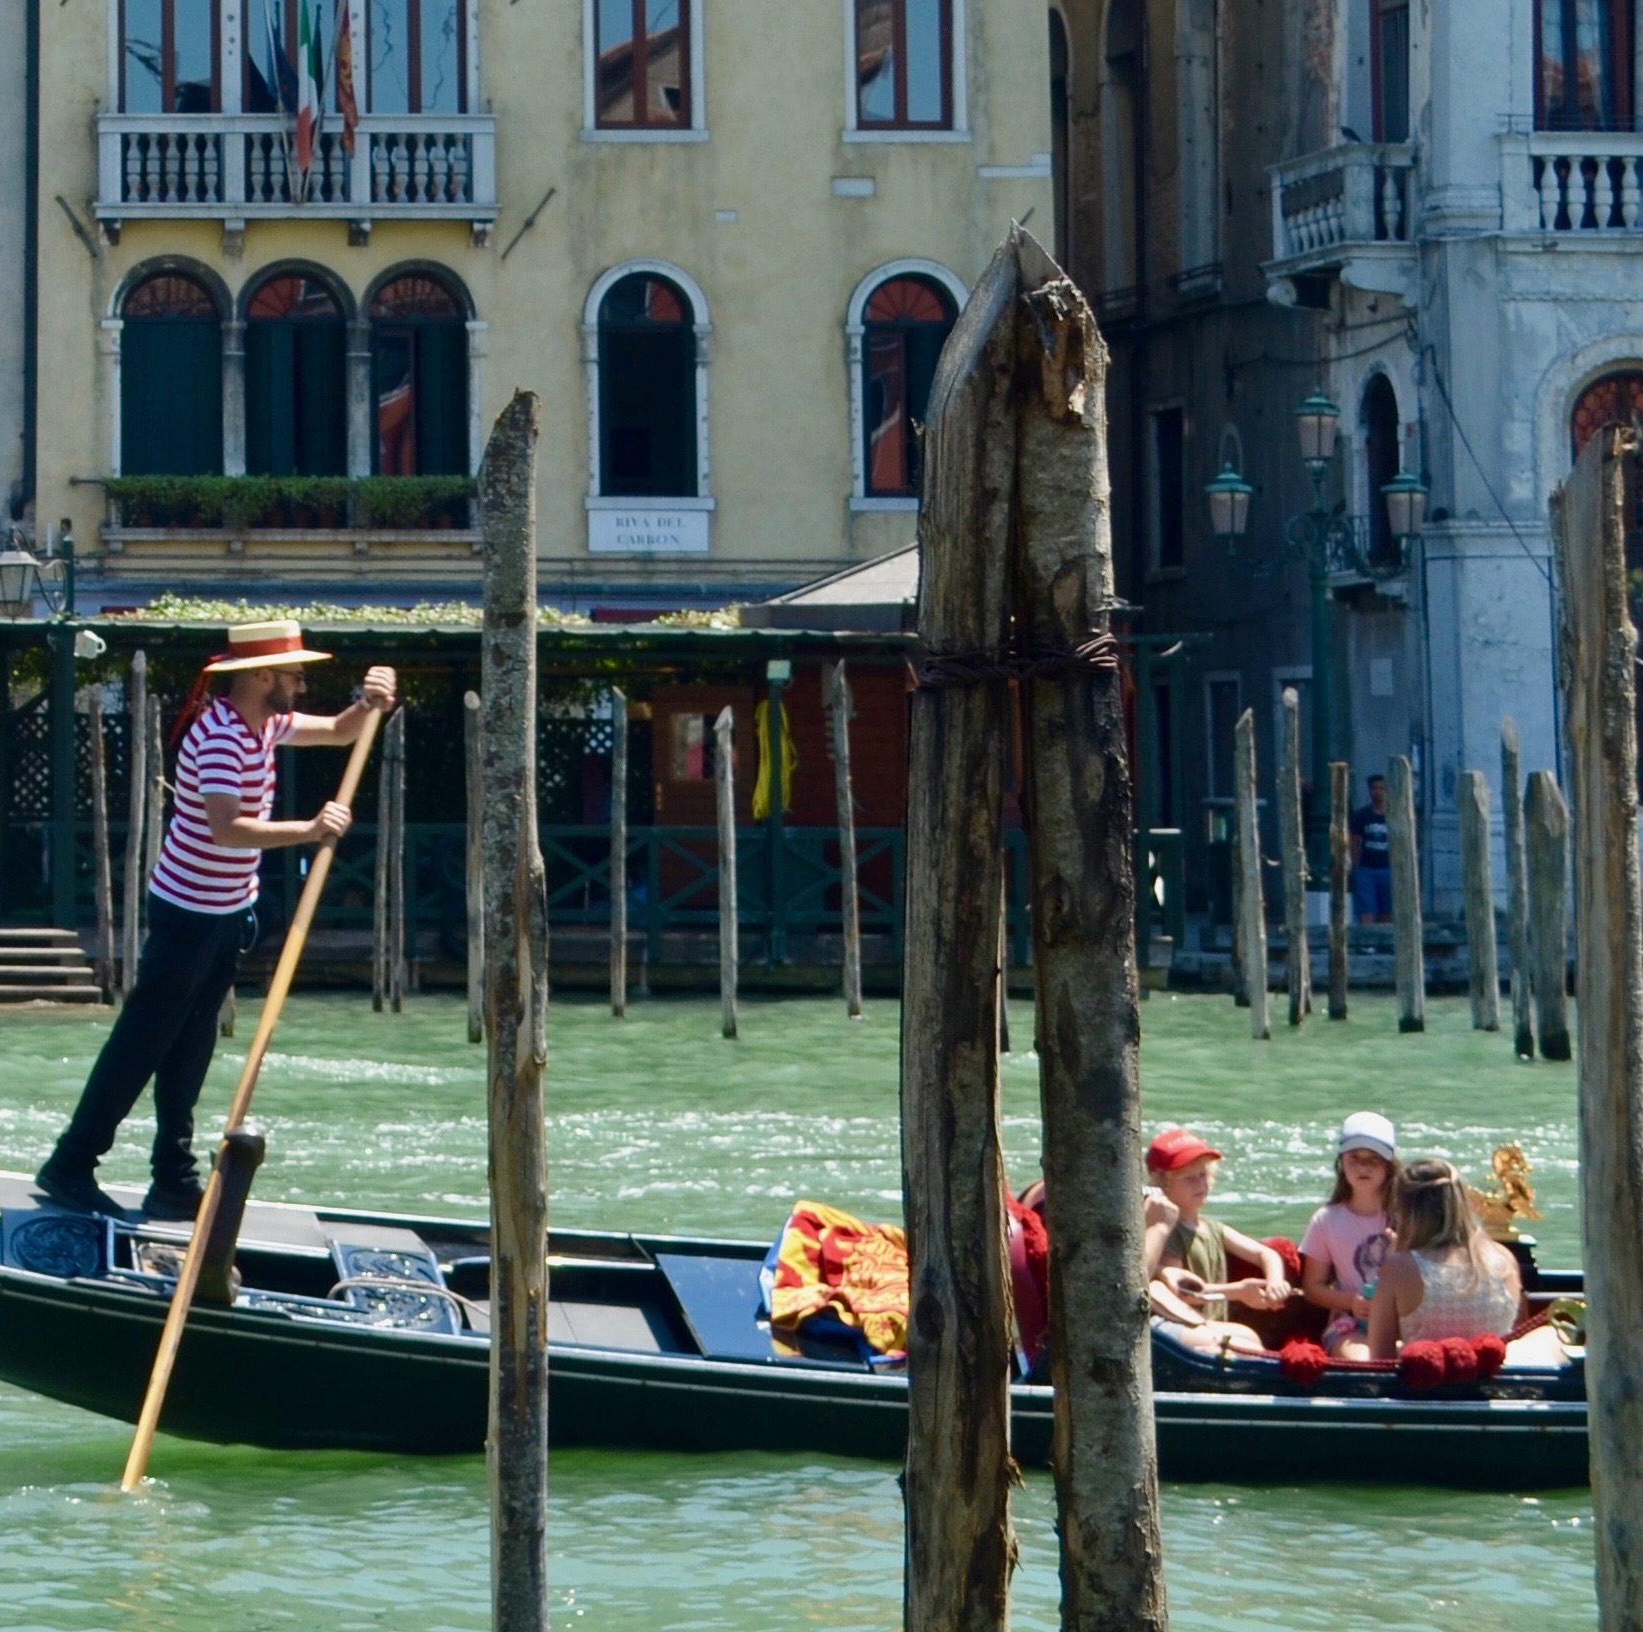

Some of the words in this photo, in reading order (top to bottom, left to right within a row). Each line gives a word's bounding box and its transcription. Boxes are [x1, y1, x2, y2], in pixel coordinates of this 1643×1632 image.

[615, 517, 650, 528] RIVA
[657, 517, 685, 528] DEL
[616, 534, 680, 545] CARBON
